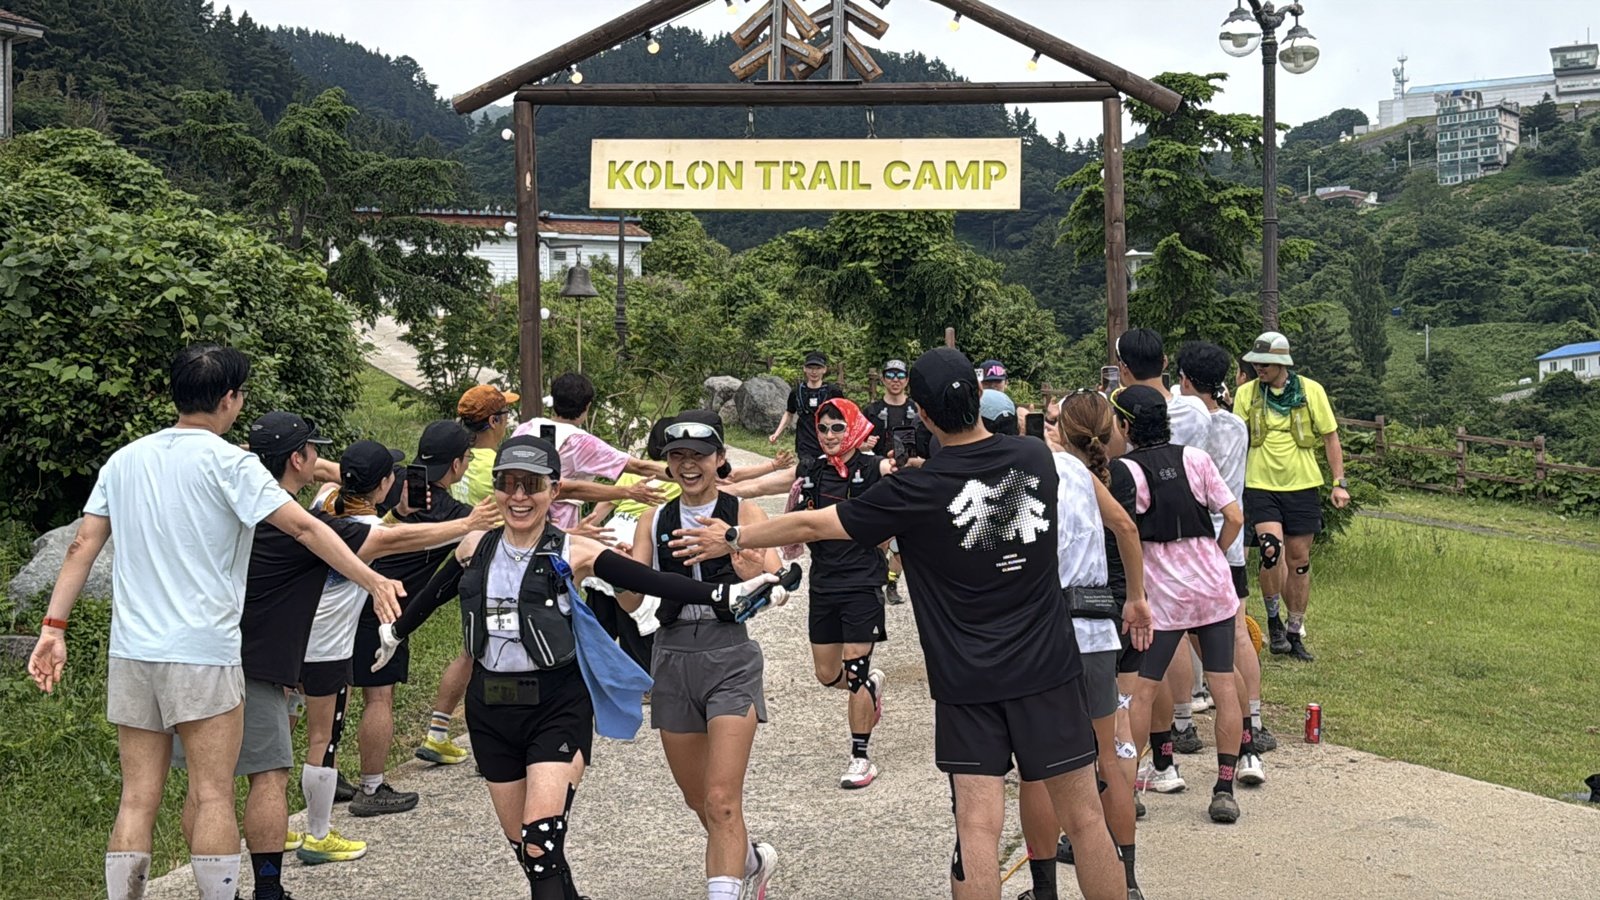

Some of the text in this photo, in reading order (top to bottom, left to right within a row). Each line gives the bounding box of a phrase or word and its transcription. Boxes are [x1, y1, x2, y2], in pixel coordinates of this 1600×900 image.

[607, 160, 1008, 190] KOLON TRAIL CAMP
